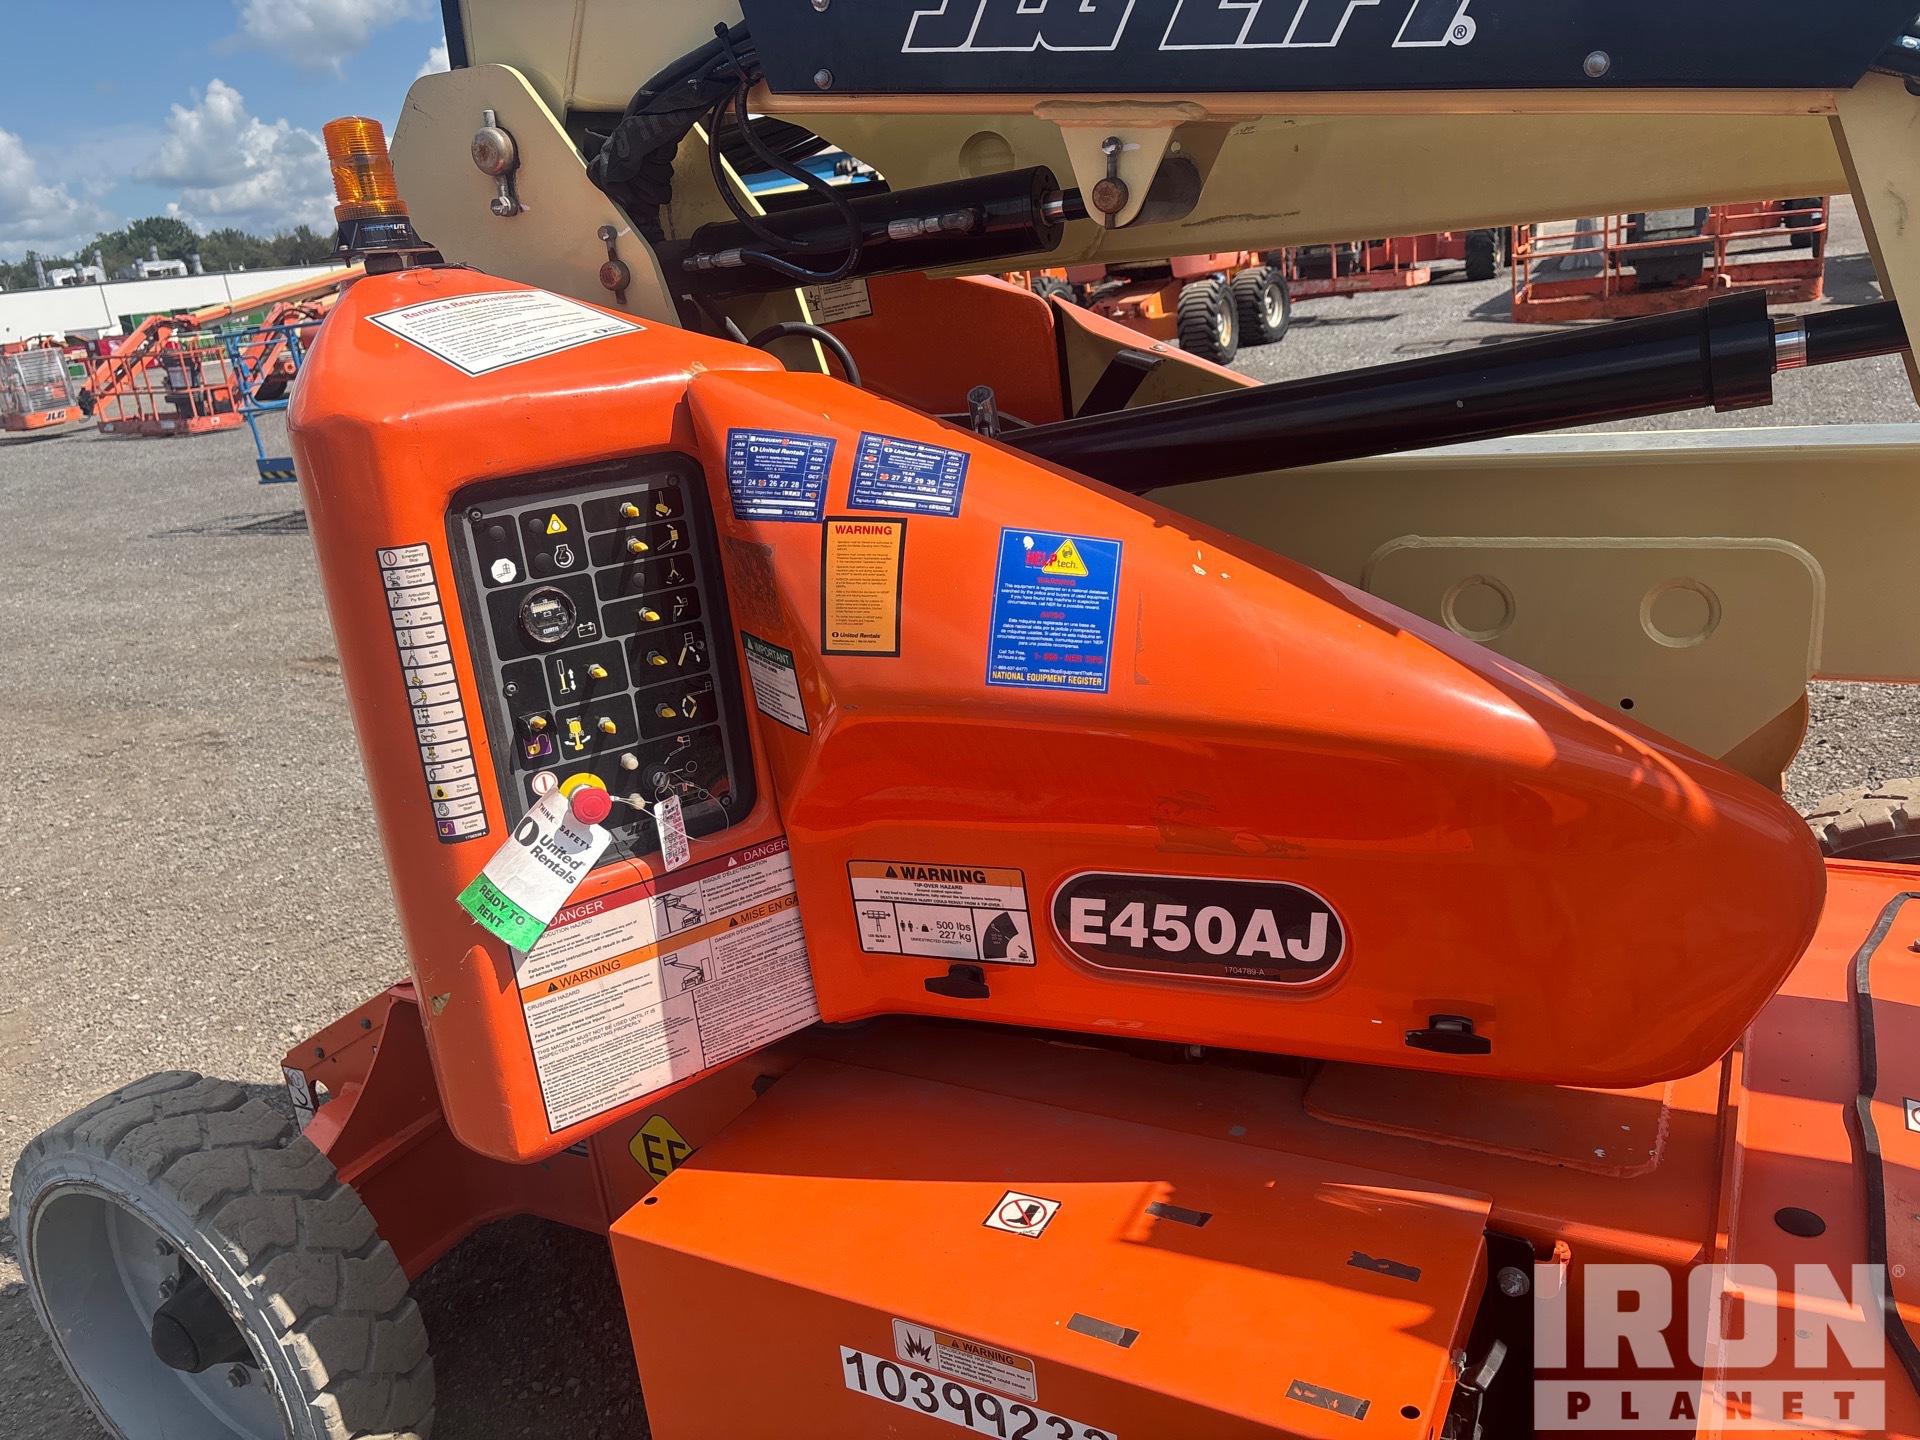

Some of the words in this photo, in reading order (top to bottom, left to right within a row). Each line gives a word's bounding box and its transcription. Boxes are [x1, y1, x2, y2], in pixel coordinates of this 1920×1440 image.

[401, 303, 450, 320] Renter's
[450, 293, 535, 308] Responsibilities
[503, 350, 523, 359] Thank
[45, 409, 66, 421] JLG
[781, 448, 804, 456] Rentals
[893, 448, 916, 456] United
[916, 452, 940, 460] Rentals
[835, 524, 893, 535] WARNING
[1037, 576, 1076, 586] WARNING
[543, 626, 560, 635] CURTIS
[753, 641, 789, 666] IMPORTANT
[1064, 654, 1082, 662] NER
[1085, 655, 1103, 663] TIPS
[991, 670, 1024, 680] NATIONAL
[1026, 673, 1066, 683] EQUIPMENT
[1067, 676, 1102, 686] REGISTER
[539, 802, 555, 822] THINK
[559, 824, 592, 851] SAFETY
[627, 820, 652, 837] JLG
[540, 834, 584, 870] United
[743, 840, 789, 862] DANGER
[530, 845, 577, 885] Rentals
[702, 874, 721, 884] RISQUE
[721, 858, 767, 878] D'ÉLECTROCUTION
[899, 866, 986, 883] WARNING
[476, 903, 505, 928] RENT
[479, 884, 510, 912] READY
[510, 909, 526, 926] TO
[740, 906, 765, 923] MISE
[767, 900, 782, 913] EN
[571, 919, 593, 930] HAZARD
[714, 931, 736, 943] DANGER
[736, 917, 772, 935] D'ÉCRASEMENT
[935, 920, 954, 930] 500
[955, 921, 971, 931] lbs
[1070, 897, 1329, 962] E450AJ
[938, 930, 956, 939] 227
[958, 931, 972, 942] kg
[558, 958, 621, 989] WARNING
[1224, 966, 1266, 976] 1704789-A
[527, 996, 557, 1012] CRUSHING
[557, 987, 580, 1001] HAZARD
[537, 1047, 550, 1056] THIS
[550, 1037, 575, 1051] MACHINE
[576, 1031, 592, 1041] MUST
[592, 1027, 604, 1035] NOT
[612, 1018, 627, 1028] USED
[628, 1012, 643, 1022] UNTIL
[539, 1045, 569, 1061] INSPECTED
[569, 1040, 582, 1050] AND
[582, 1029, 613, 1045] OPERATING
[613, 1018, 641, 1033] PROPERLY.
[962, 1342, 1014, 1365] WARNING
[940, 1359, 956, 1368] Failure
[962, 1366, 976, 1374] follow
[977, 1370, 996, 1380] warning
[996, 1377, 1010, 1385] could
[1011, 1381, 1025, 1389] cause
[940, 1364, 953, 1372] death
[960, 1370, 977, 1379] serious
[978, 1376, 993, 1385] injury.
[846, 1352, 1109, 1440] 1039923
